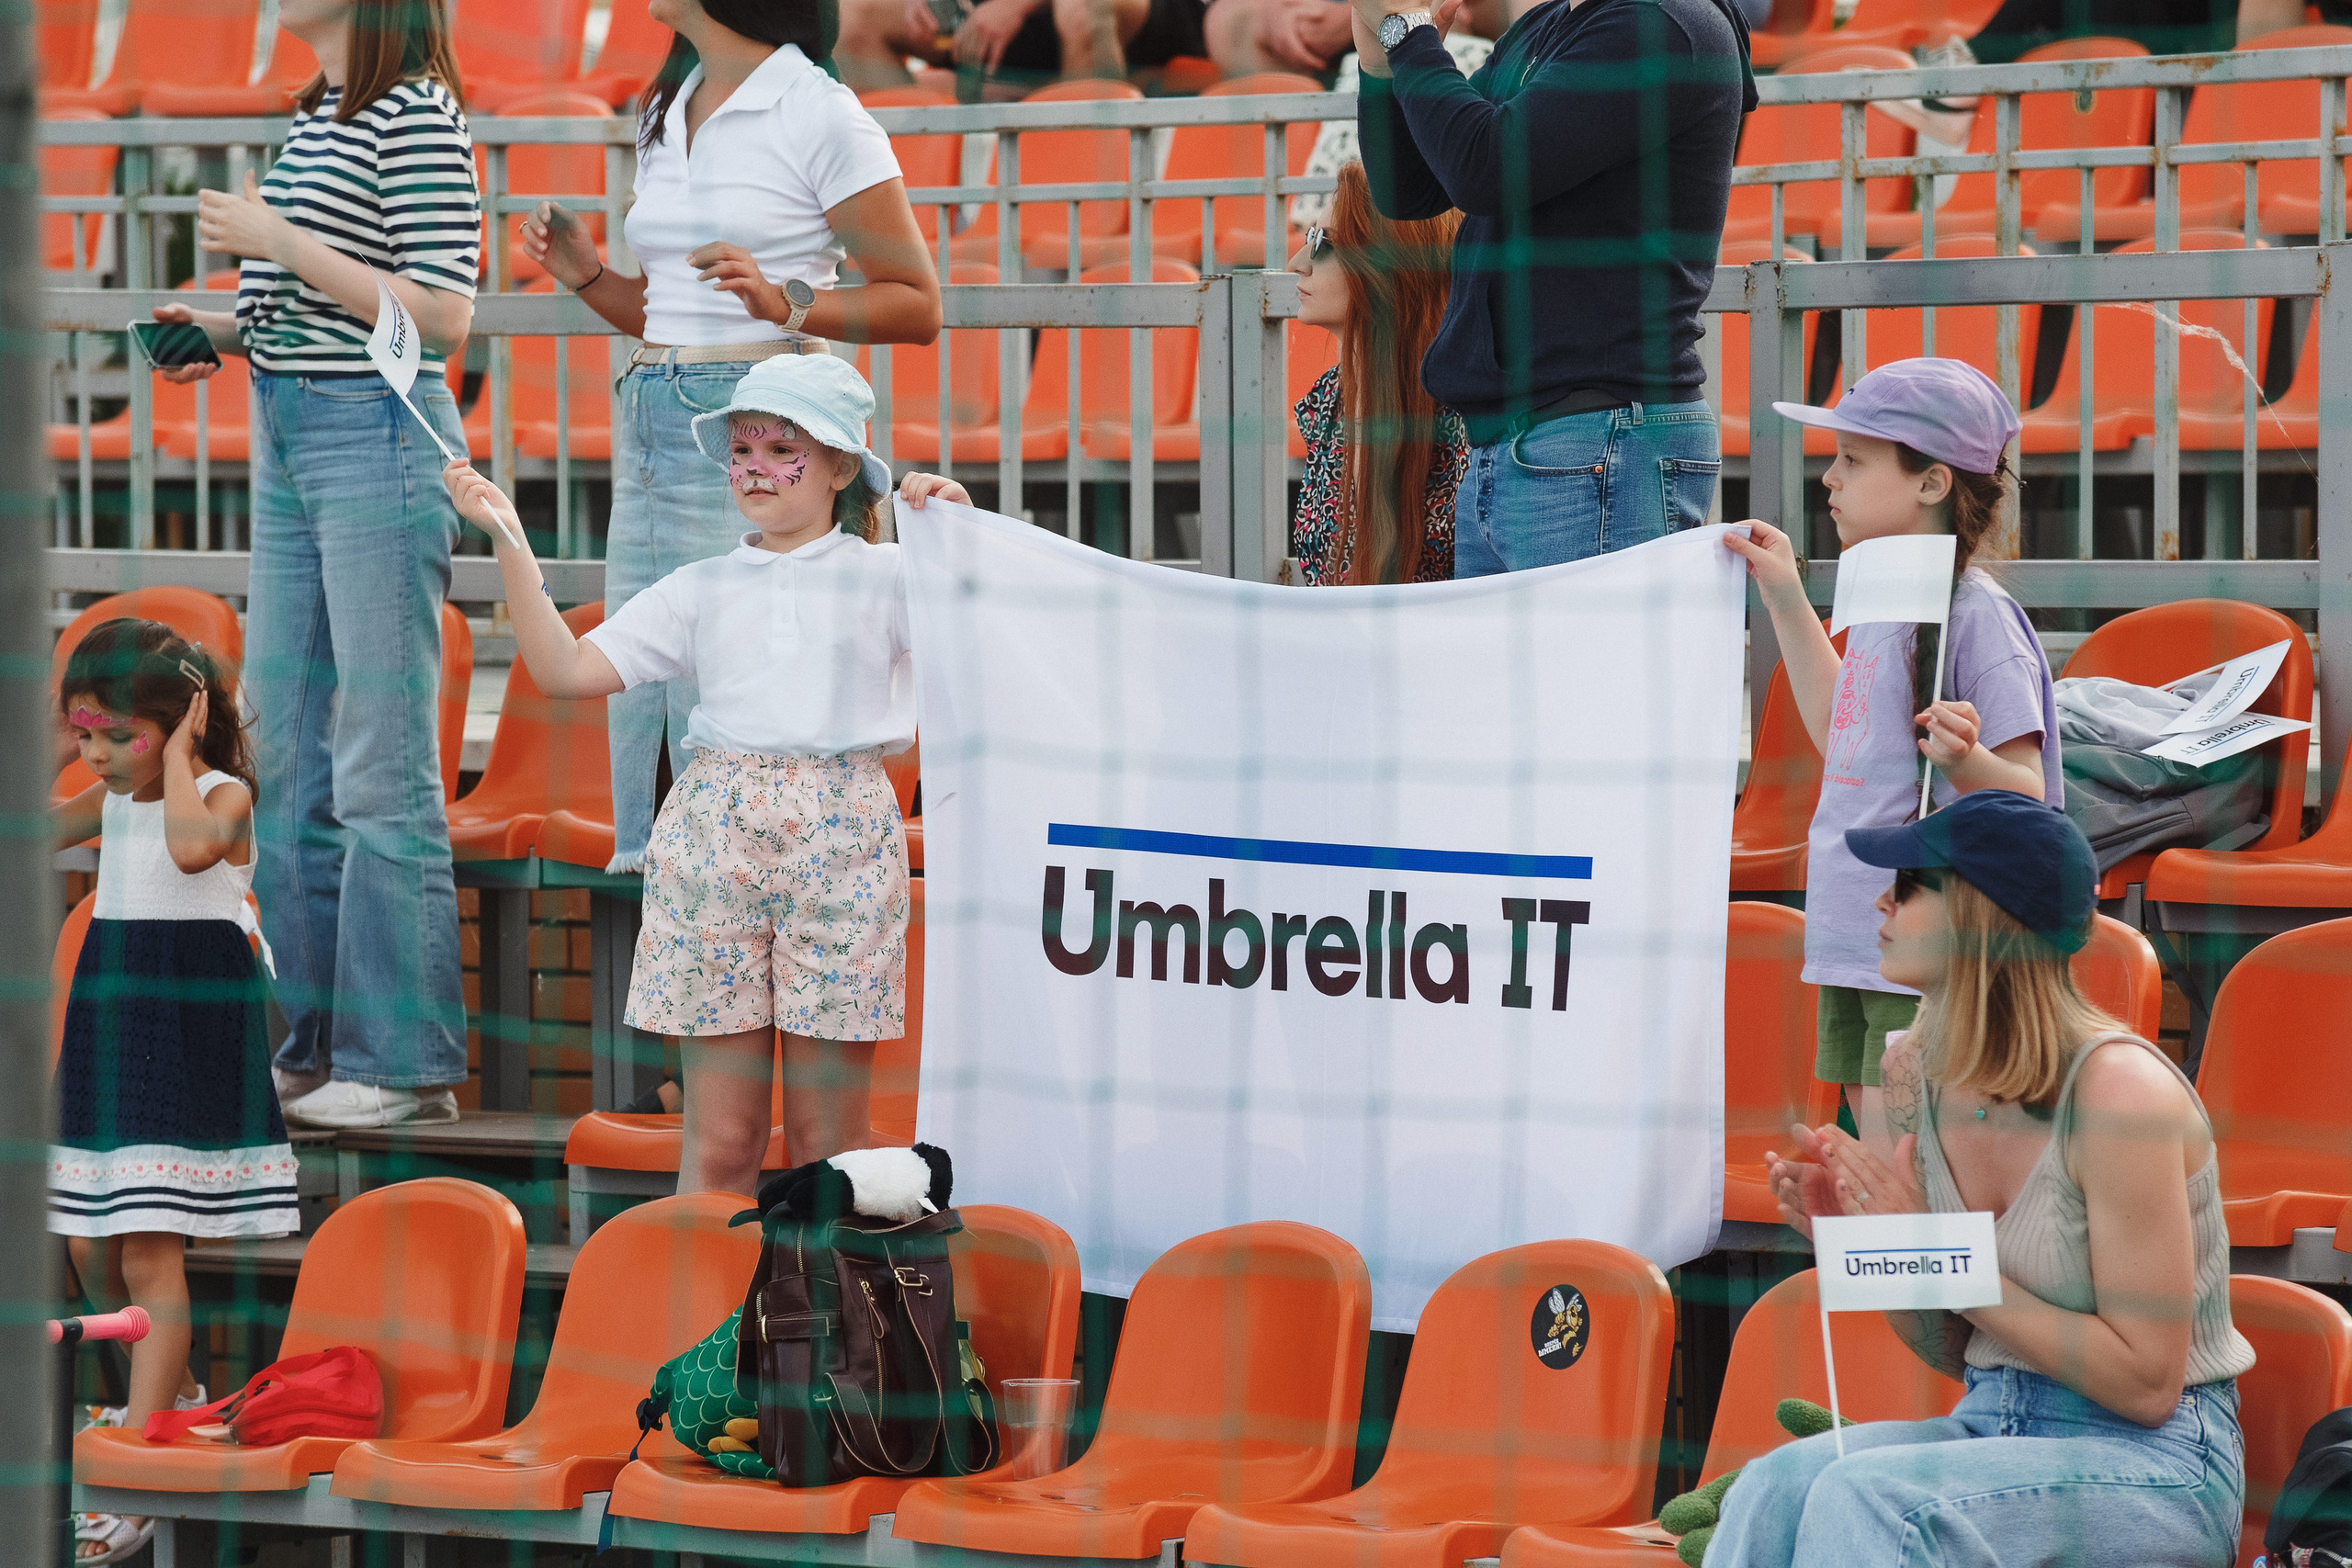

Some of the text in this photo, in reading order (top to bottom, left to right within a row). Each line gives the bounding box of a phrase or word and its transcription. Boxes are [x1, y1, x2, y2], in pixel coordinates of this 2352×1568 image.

[392, 299, 406, 359] Umbr
[2207, 667, 2255, 714] Umbrella
[2180, 718, 2271, 754] Umbrella IT
[1042, 865, 1591, 1011] Umbrella IT
[1846, 1255, 1972, 1276] Umbrella IT
